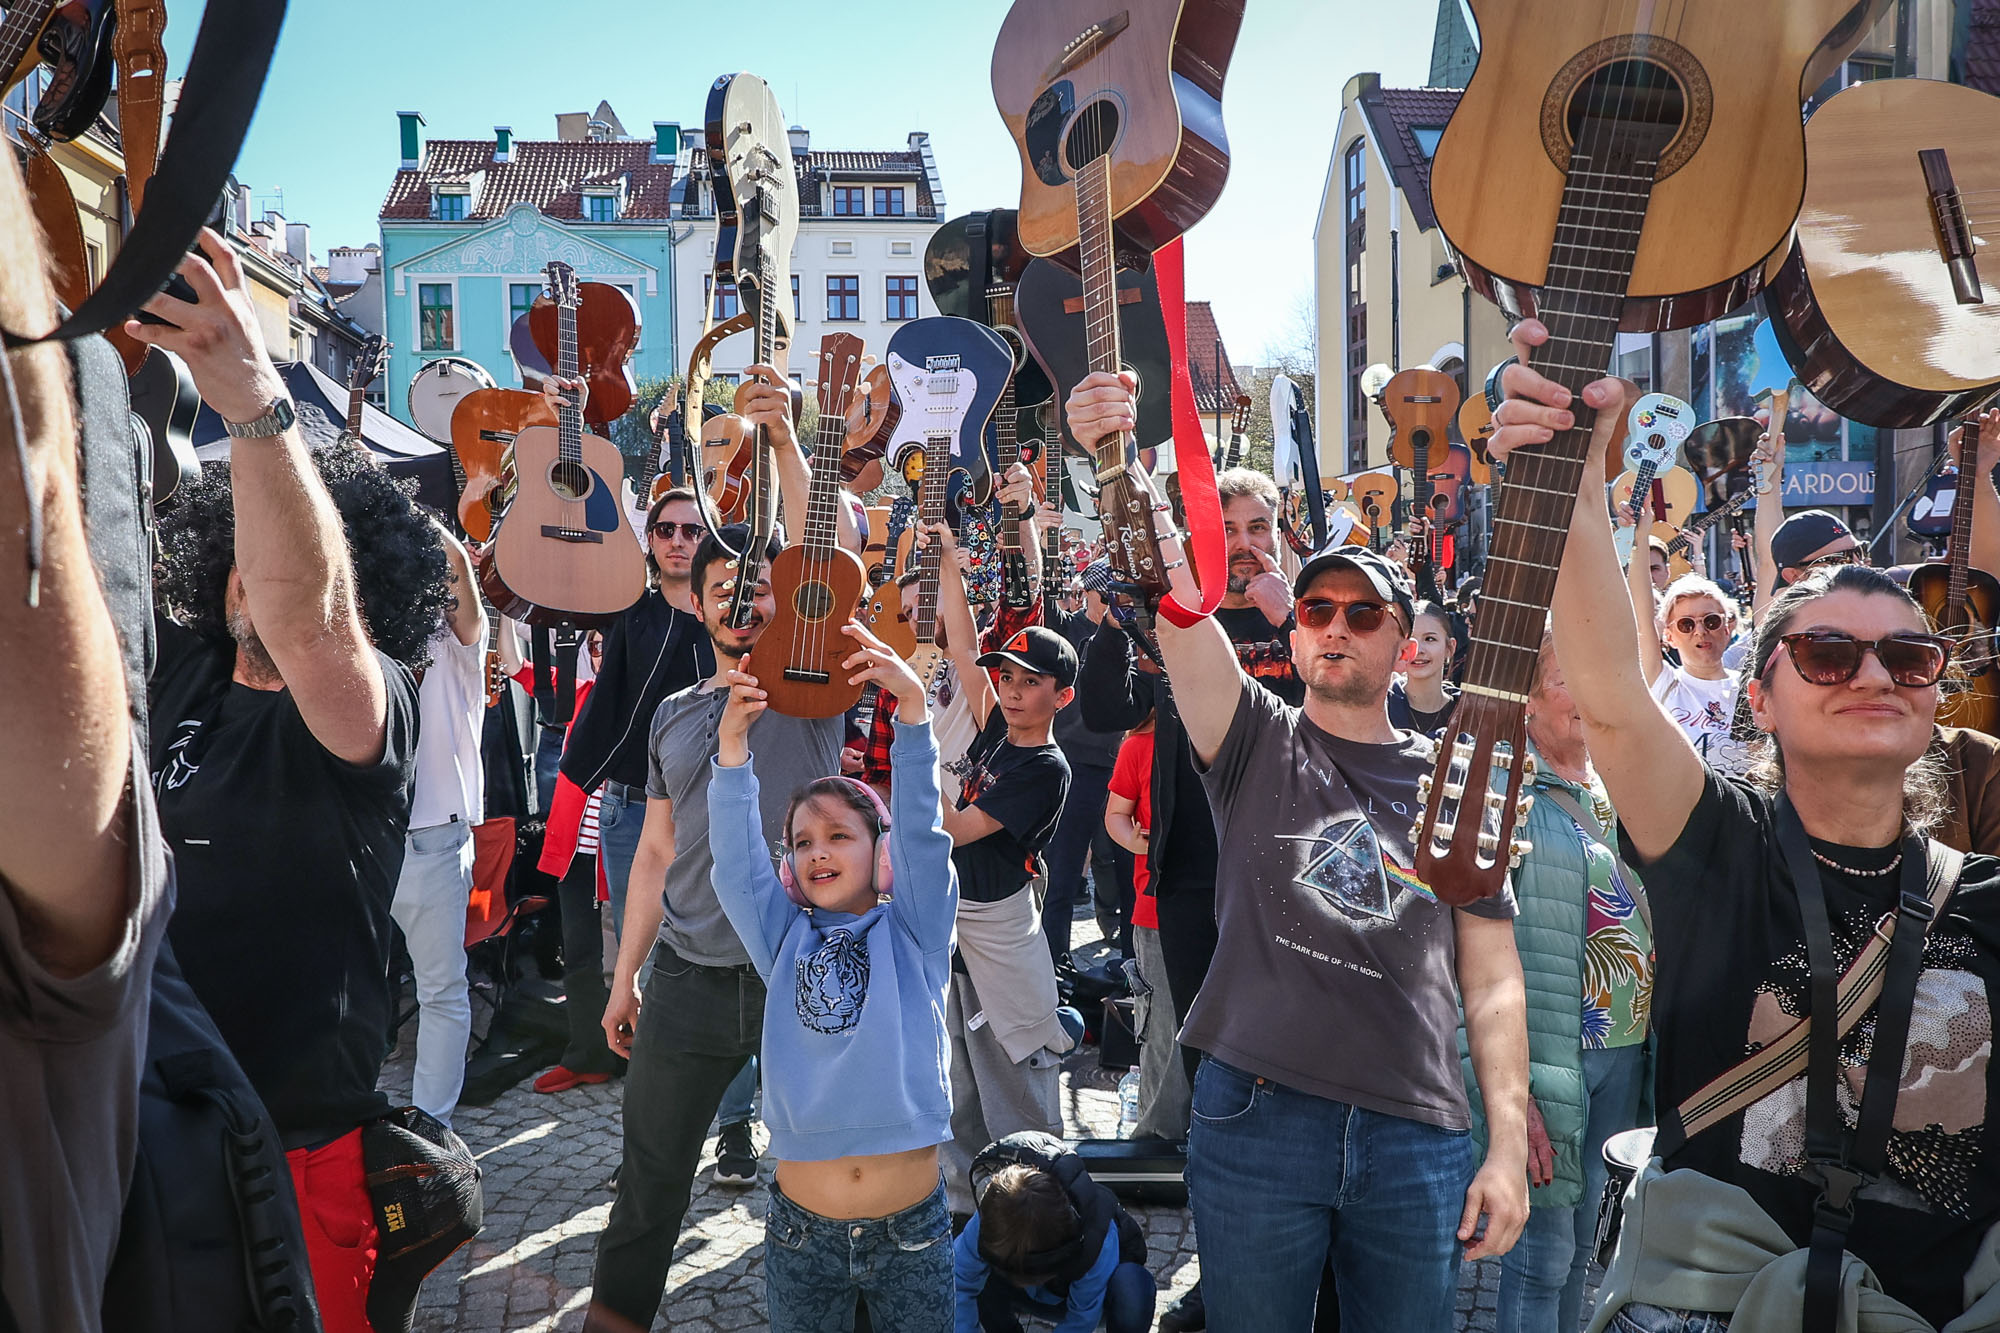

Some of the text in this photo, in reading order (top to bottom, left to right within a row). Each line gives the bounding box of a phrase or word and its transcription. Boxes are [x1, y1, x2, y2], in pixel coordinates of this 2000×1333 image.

[1275, 935, 1291, 947] THE
[1290, 942, 1311, 956] DARK
[1311, 950, 1330, 962] SIDE
[1330, 957, 1342, 966] OF
[1359, 966, 1383, 980] MOON
[384, 1204, 401, 1232] SAM
